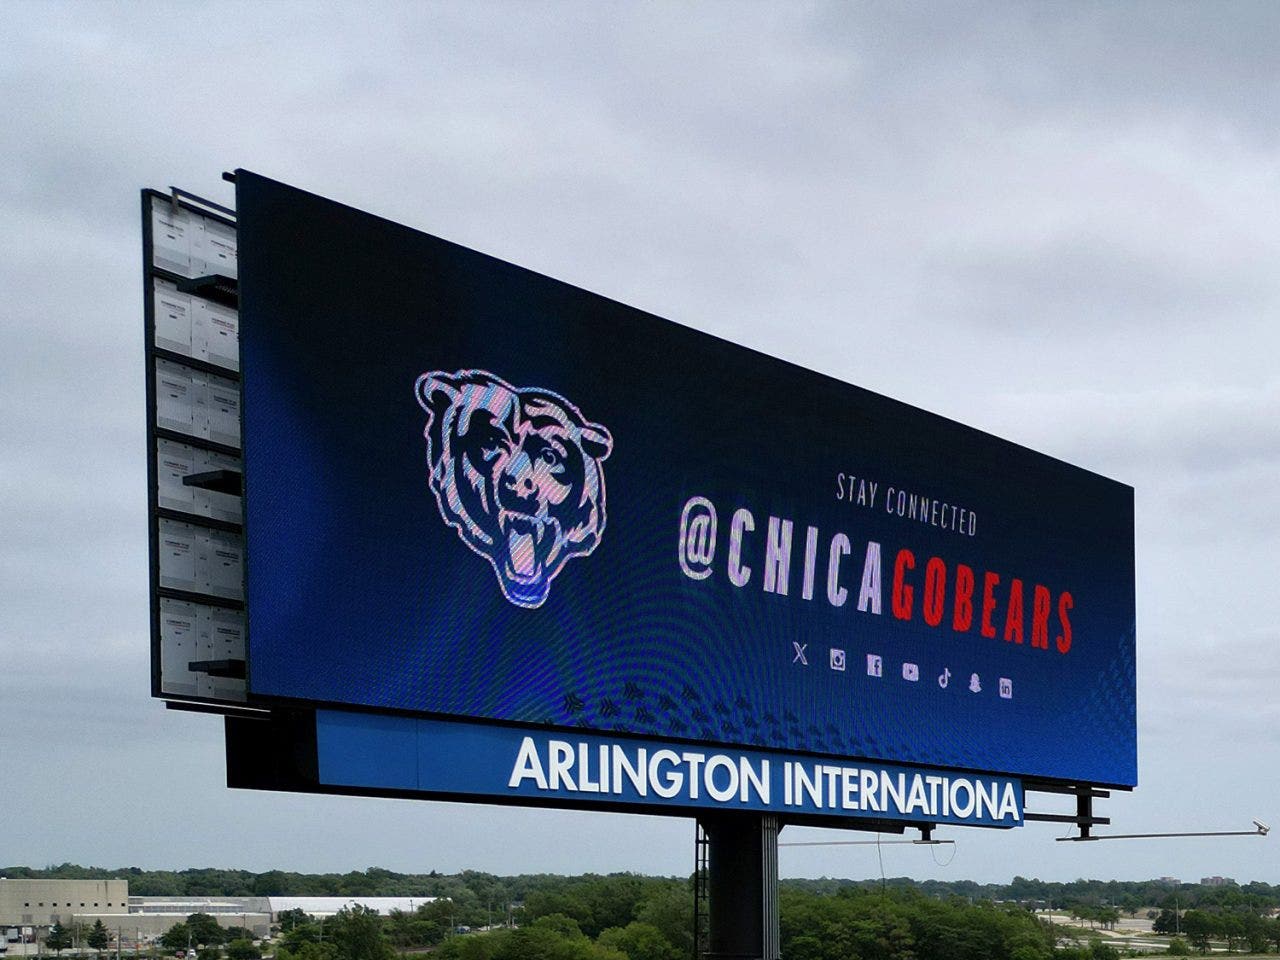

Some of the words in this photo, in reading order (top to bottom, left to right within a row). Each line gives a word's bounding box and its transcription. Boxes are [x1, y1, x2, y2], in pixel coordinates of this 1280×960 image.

[836, 472, 878, 508] STAY
[886, 487, 977, 537] CONNECTED
[678, 495, 1075, 655] @CHICAGOBEARS
[508, 736, 770, 805] ARLINGTON
[784, 761, 1020, 821] INTERNATIONA
